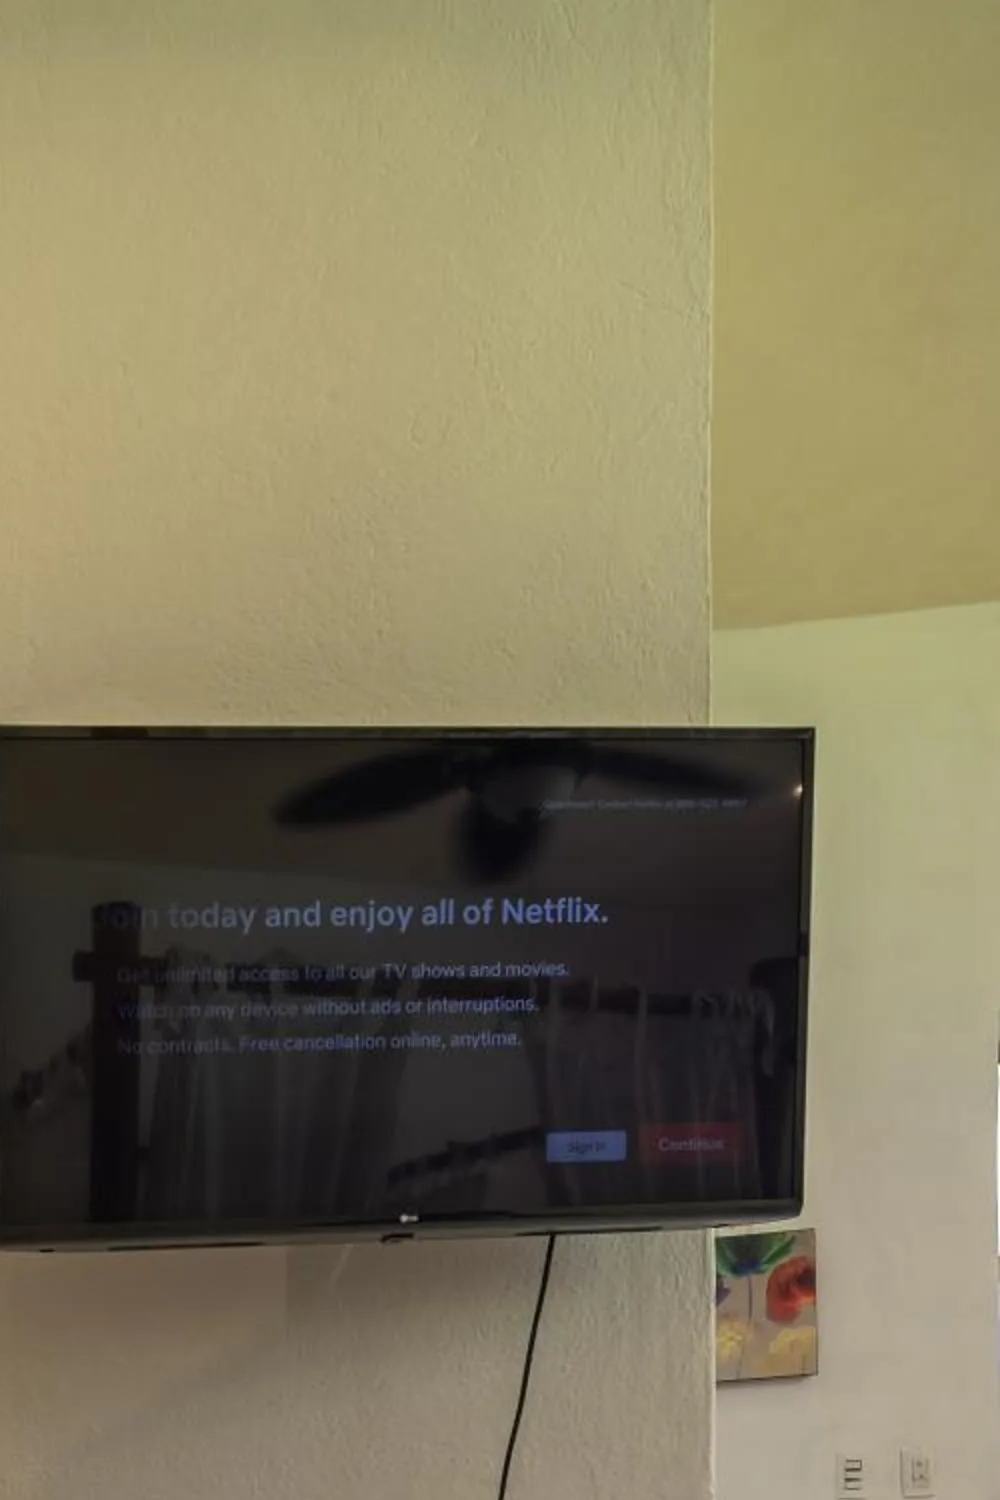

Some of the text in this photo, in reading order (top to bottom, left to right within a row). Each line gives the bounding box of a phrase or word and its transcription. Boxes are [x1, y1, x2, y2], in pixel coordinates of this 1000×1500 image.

[168, 901, 256, 934] today
[265, 899, 322, 927] and
[329, 900, 413, 933] enjoy
[421, 898, 455, 925] all
[462, 898, 494, 925] of
[502, 896, 609, 925] Netflix.
[239, 966, 300, 983] access
[305, 965, 323, 982] to
[325, 963, 347, 982] all
[349, 966, 377, 981] our
[383, 962, 407, 979] TV
[410, 961, 466, 979] shows
[469, 961, 502, 978] and
[505, 960, 570, 977] movies.
[203, 1003, 237, 1022] any
[240, 999, 299, 1017] device
[302, 998, 367, 1016] without
[370, 996, 402, 1014] ads
[405, 998, 424, 1013] or
[426, 995, 541, 1015] interruptions.
[238, 1033, 281, 1050] Free
[283, 1030, 387, 1050] cancellation
[390, 1029, 447, 1048] online,
[450, 1028, 522, 1050] anytime.
